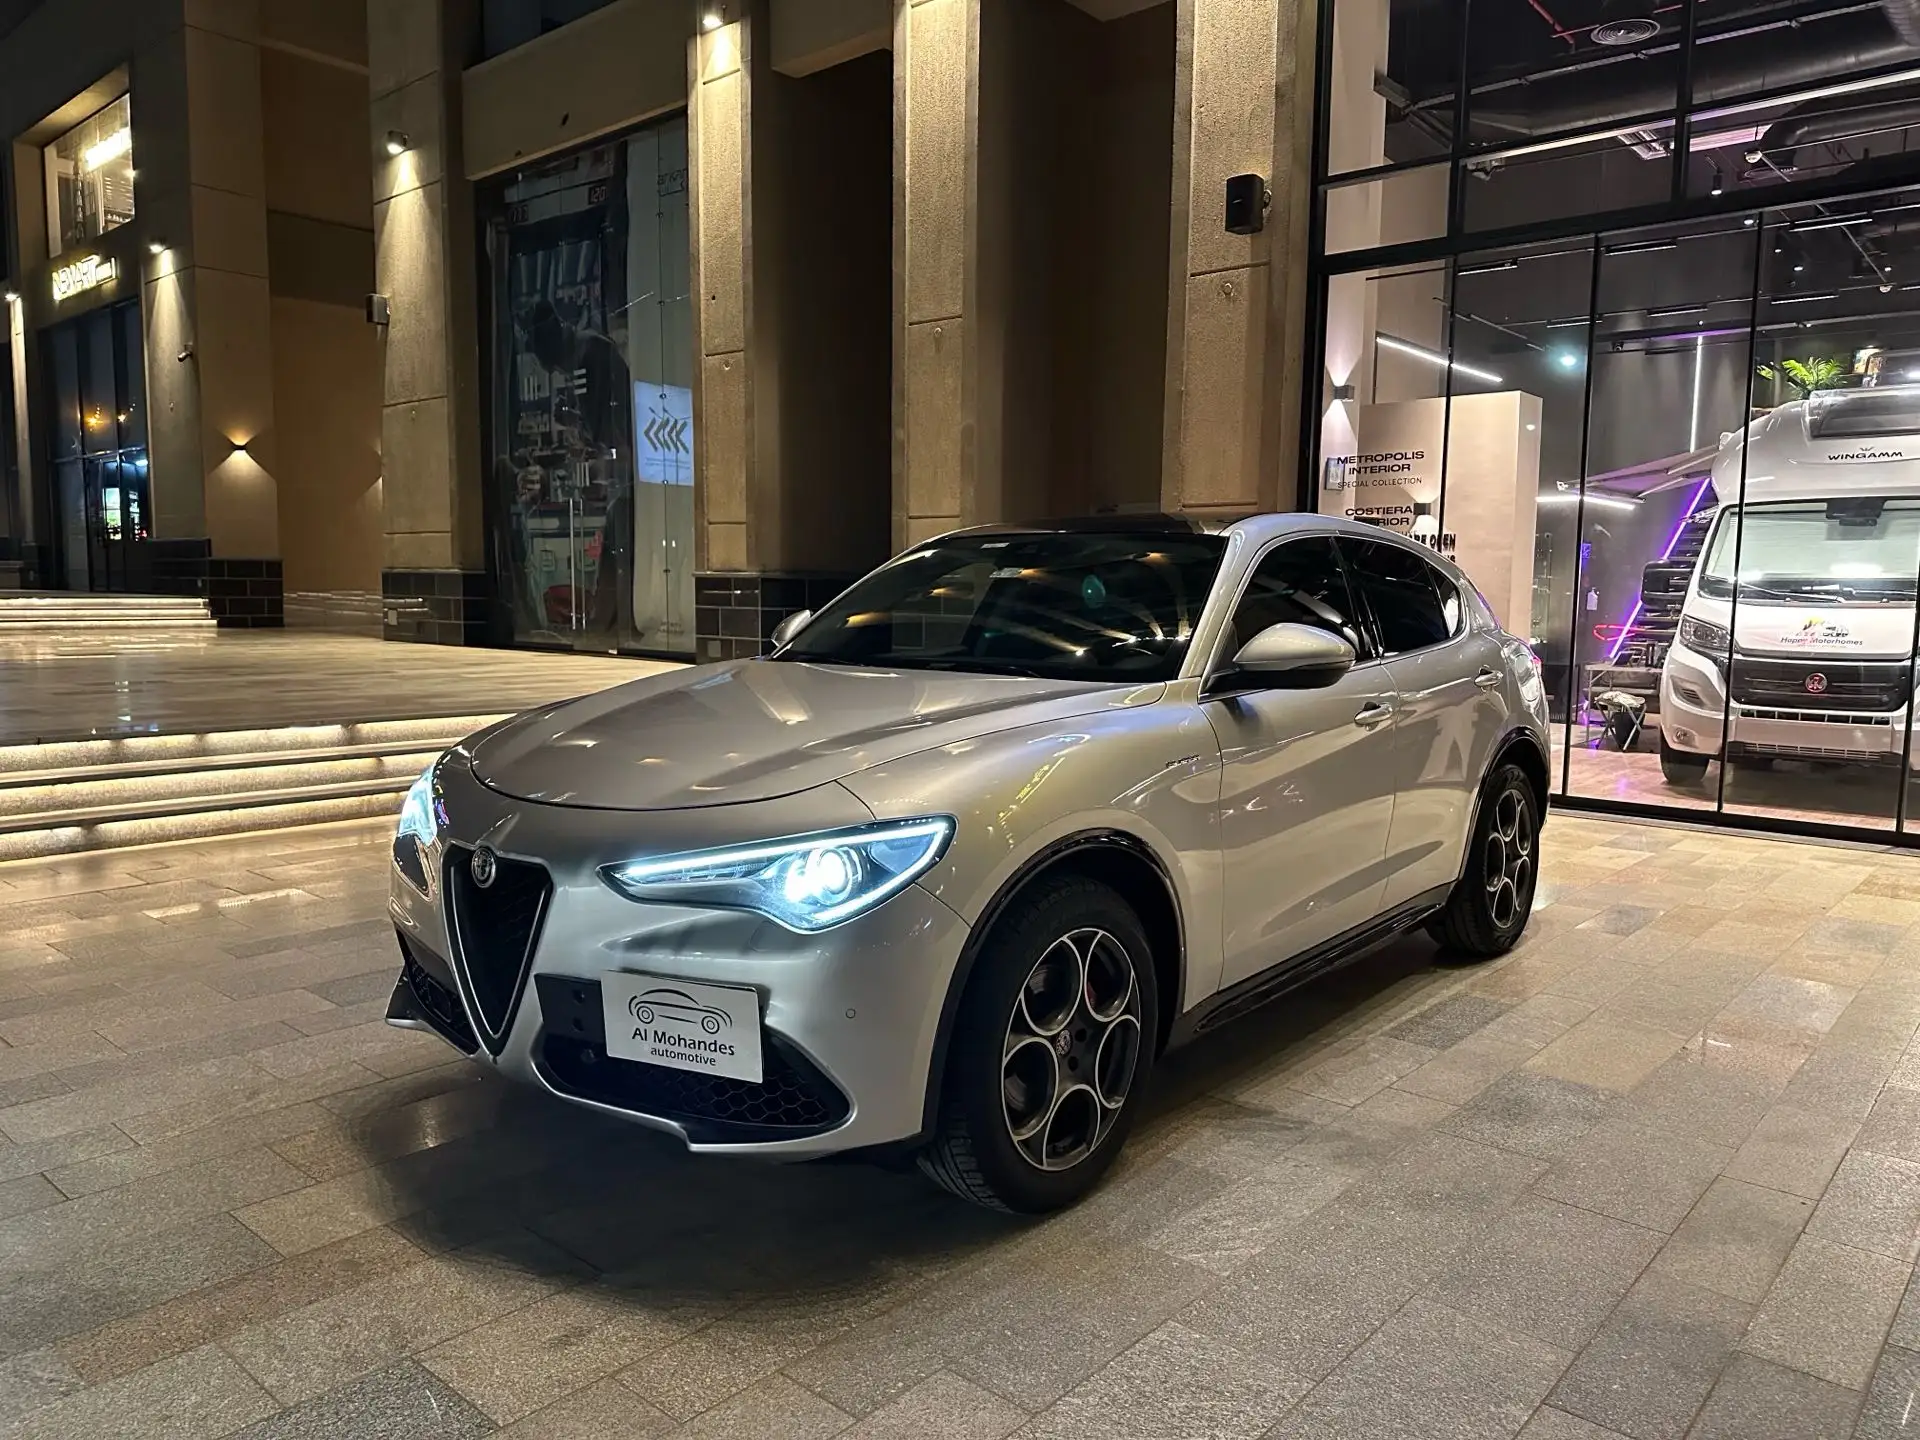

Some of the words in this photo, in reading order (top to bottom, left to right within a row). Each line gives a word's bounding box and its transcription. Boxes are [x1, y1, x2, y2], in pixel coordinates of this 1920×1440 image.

[1337, 450, 1425, 464] METROPOLIS
[1827, 451, 1903, 461] WINGAMM
[1348, 463, 1411, 475] INTERIOR
[1337, 480, 1369, 488] SPECIAL
[1371, 477, 1422, 487] COLLECTION
[1345, 505, 1413, 516] COSTIERA
[1810, 637, 1863, 645] Motorhomes
[632, 1027, 648, 1041] Al
[653, 1030, 735, 1055] Mohandes
[650, 1047, 716, 1066] automotive
